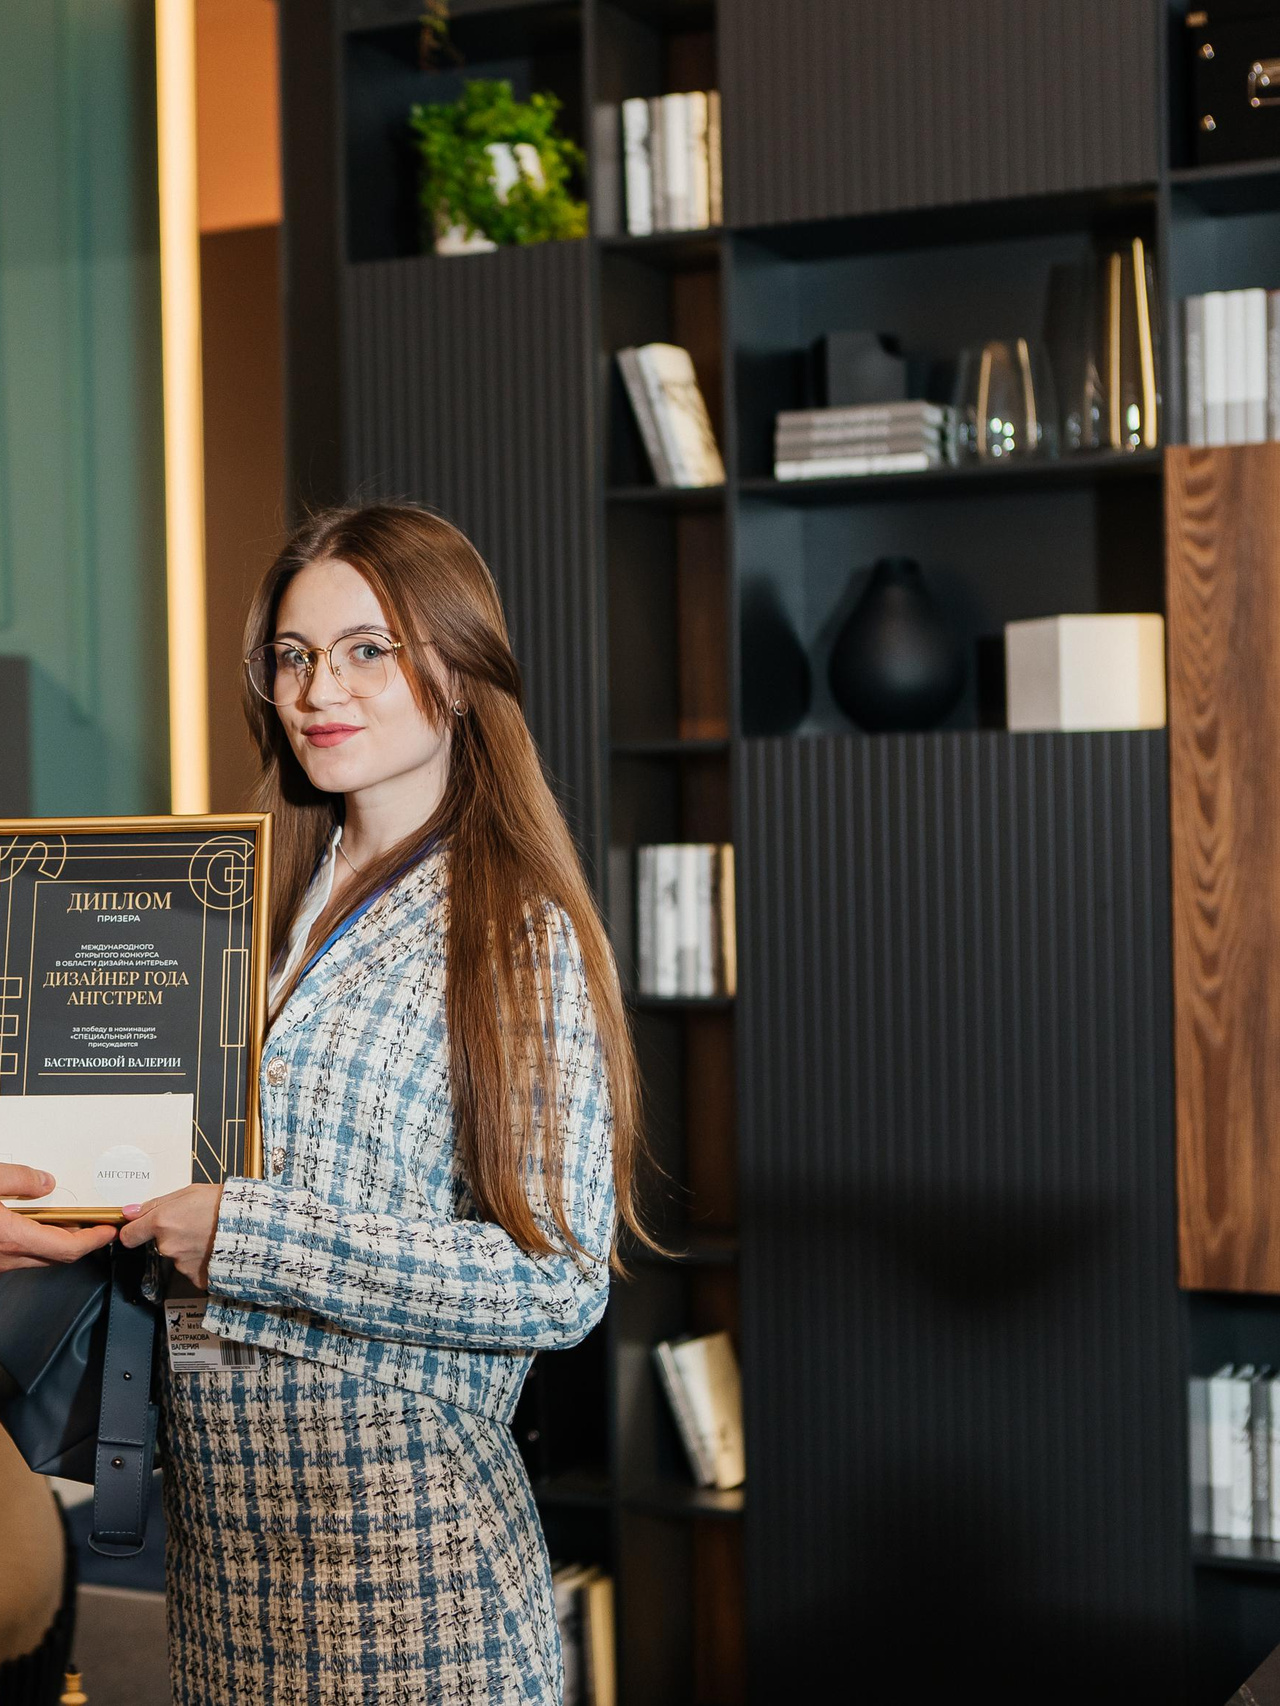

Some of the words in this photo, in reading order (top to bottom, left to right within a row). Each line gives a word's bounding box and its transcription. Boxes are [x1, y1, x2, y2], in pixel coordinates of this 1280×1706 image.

[66, 891, 172, 914] ДИПЛОМ
[97, 914, 141, 922] ПРИЗЕРА
[80, 943, 154, 951] МЕЖДУНАРОДНОГО
[74, 951, 119, 959] ОТКРЫТОГО
[120, 951, 160, 959] КОНКУРСА
[62, 959, 97, 967] ОБЛАСТИ
[97, 959, 135, 968] ДИЗАЙНА
[135, 959, 179, 967] ИНТЕРЬЕРА
[42, 968, 140, 988] ДИЗАЙНЕР
[144, 971, 190, 988] ГОДА
[66, 990, 163, 1006] АНГСТРЕМ
[81, 1025, 107, 1034] победу
[70, 1032, 132, 1041] «СПЕЦИАЛЬНЫЙ
[87, 1041, 139, 1049] присуждается
[44, 1055, 126, 1068] БАСТРАКОВОЙ
[127, 1057, 181, 1068] ВАЛЕРИИ
[97, 1170, 150, 1180] АНГСТРЕМ
